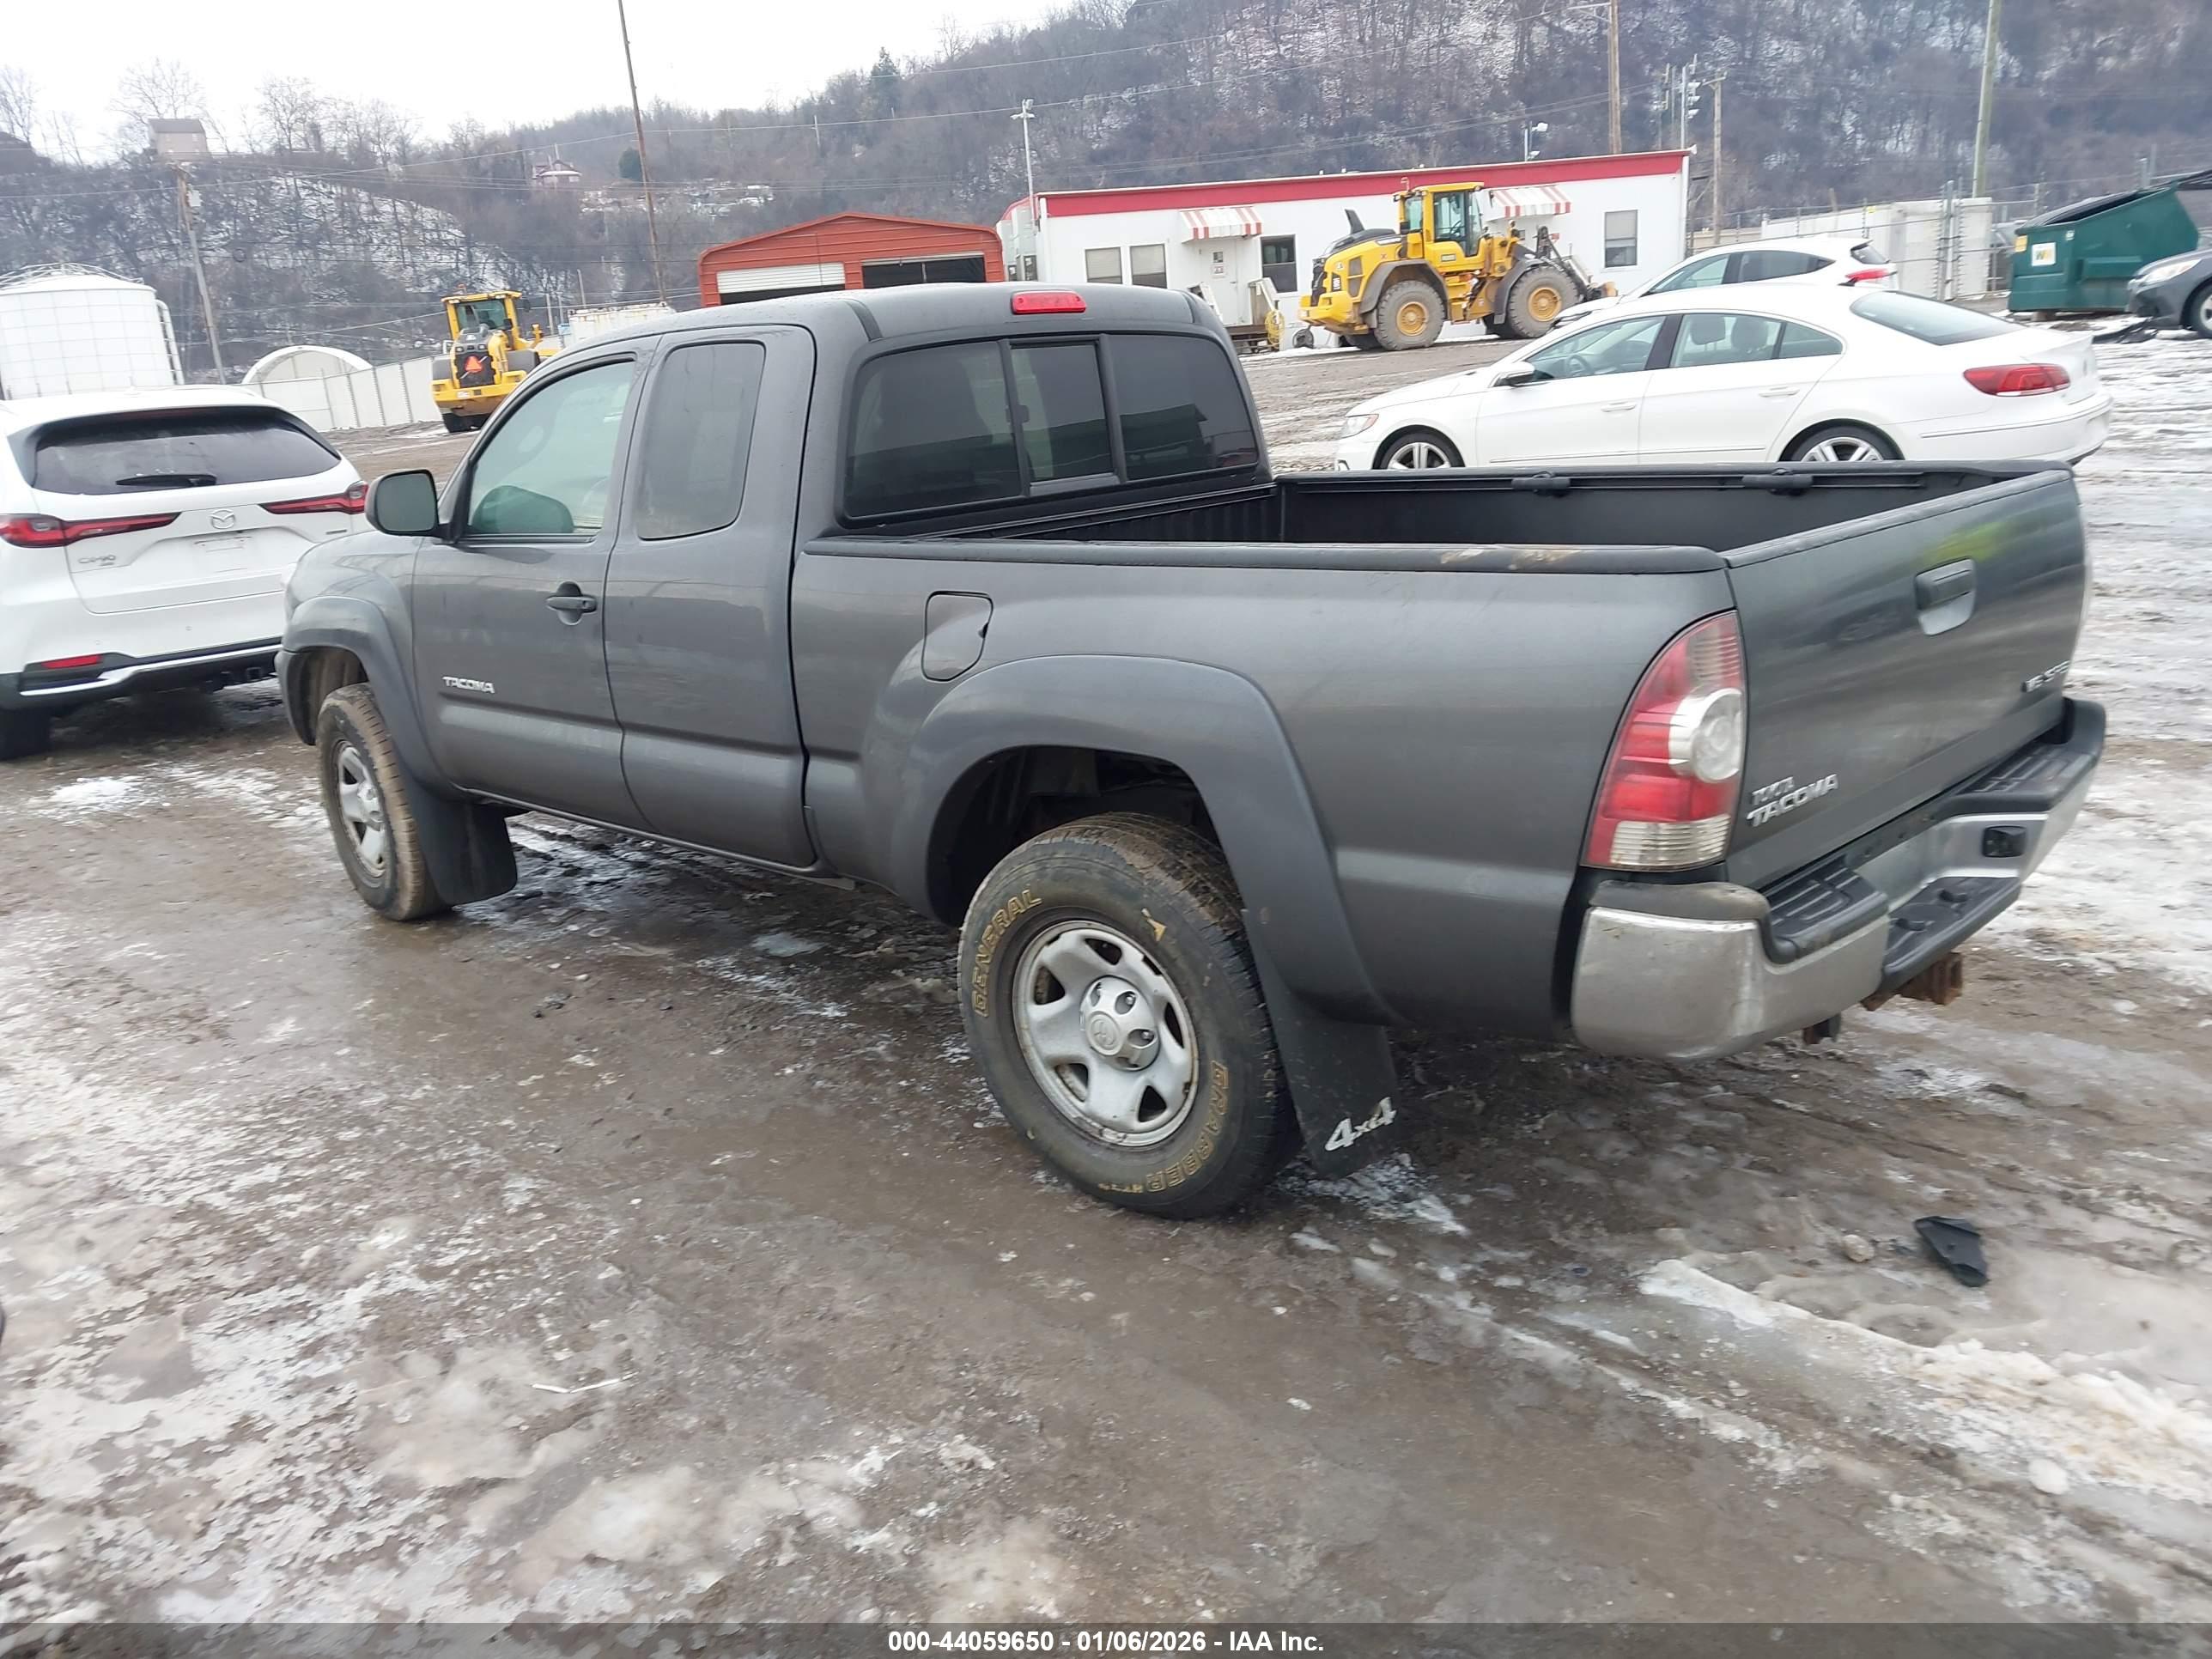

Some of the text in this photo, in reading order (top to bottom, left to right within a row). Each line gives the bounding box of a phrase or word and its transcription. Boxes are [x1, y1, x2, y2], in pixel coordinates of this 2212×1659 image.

[441, 676, 495, 694] TACOMA
[1746, 773, 1838, 827] TACOMA
[971, 889, 1042, 1017] GENERAL
[1146, 1060, 1229, 1192] GRABBER
[1324, 1097, 1397, 1151] 4x4
